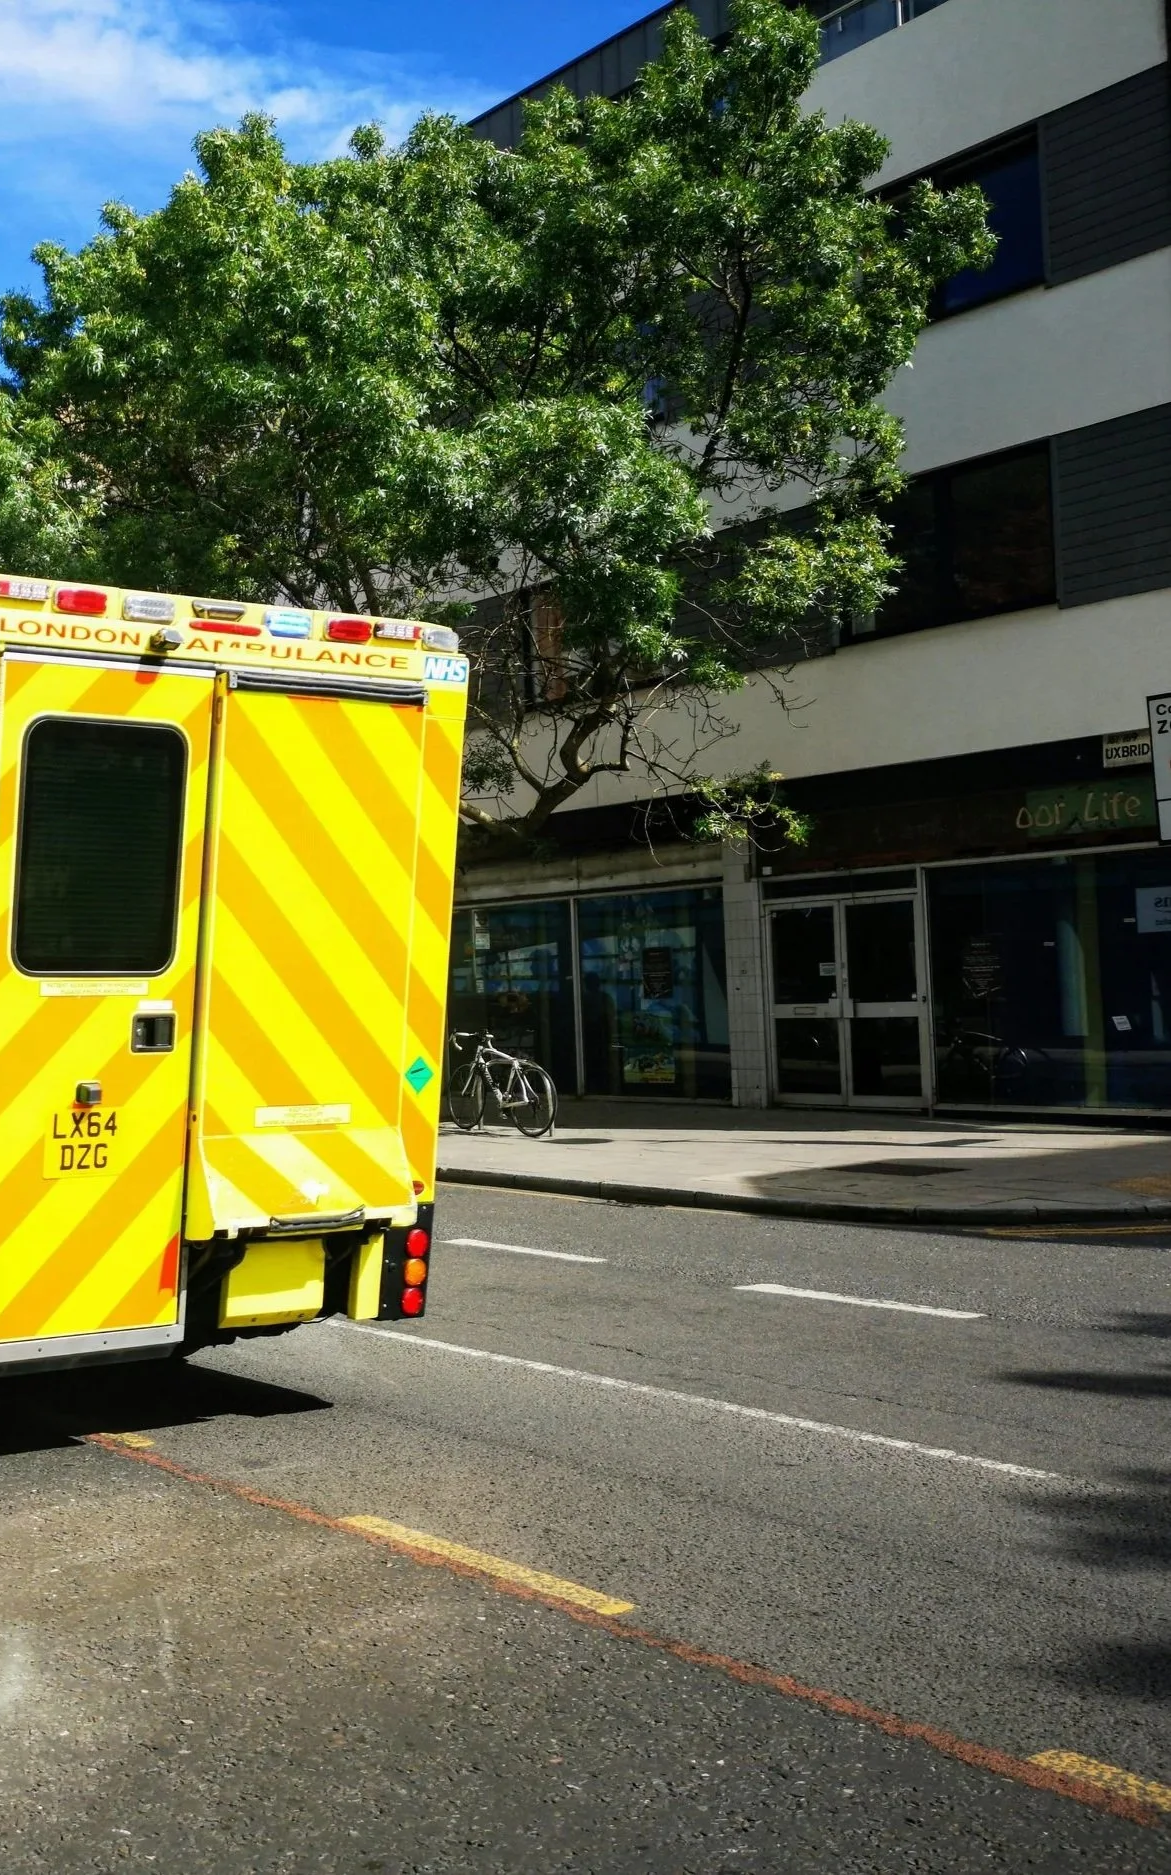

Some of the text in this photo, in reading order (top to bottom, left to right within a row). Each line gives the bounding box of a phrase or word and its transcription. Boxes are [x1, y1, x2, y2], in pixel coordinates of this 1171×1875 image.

[0, 617, 141, 646] LONDON
[425, 657, 466, 682] NHS
[53, 1111, 118, 1139] LX64
[59, 1143, 108, 1171] DZG
